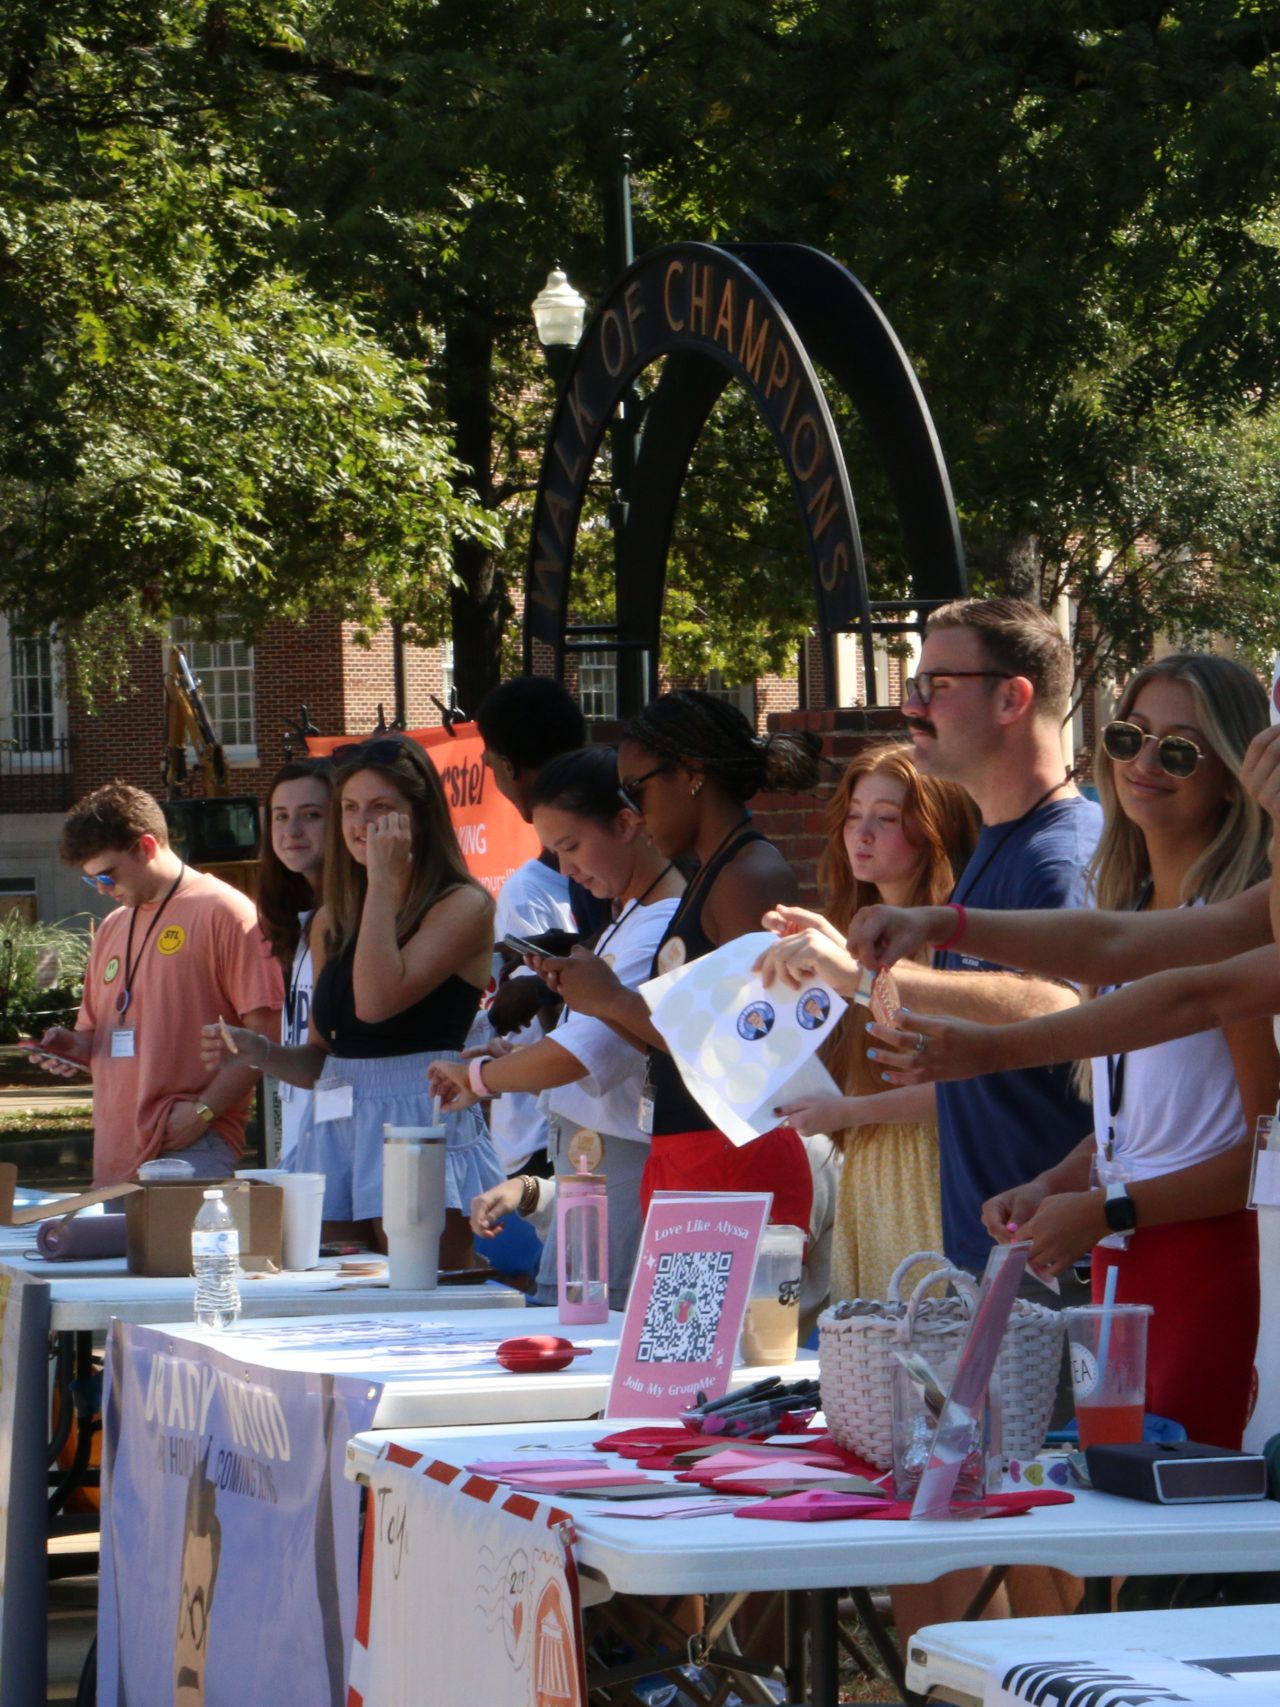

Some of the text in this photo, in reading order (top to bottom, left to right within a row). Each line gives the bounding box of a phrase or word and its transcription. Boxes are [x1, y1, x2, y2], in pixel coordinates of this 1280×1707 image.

[532, 260, 849, 612] WALK OF CHAMPIONS
[654, 1219, 750, 1242] Love Like Alyssa
[623, 1375, 717, 1397] Join My GroupMe
